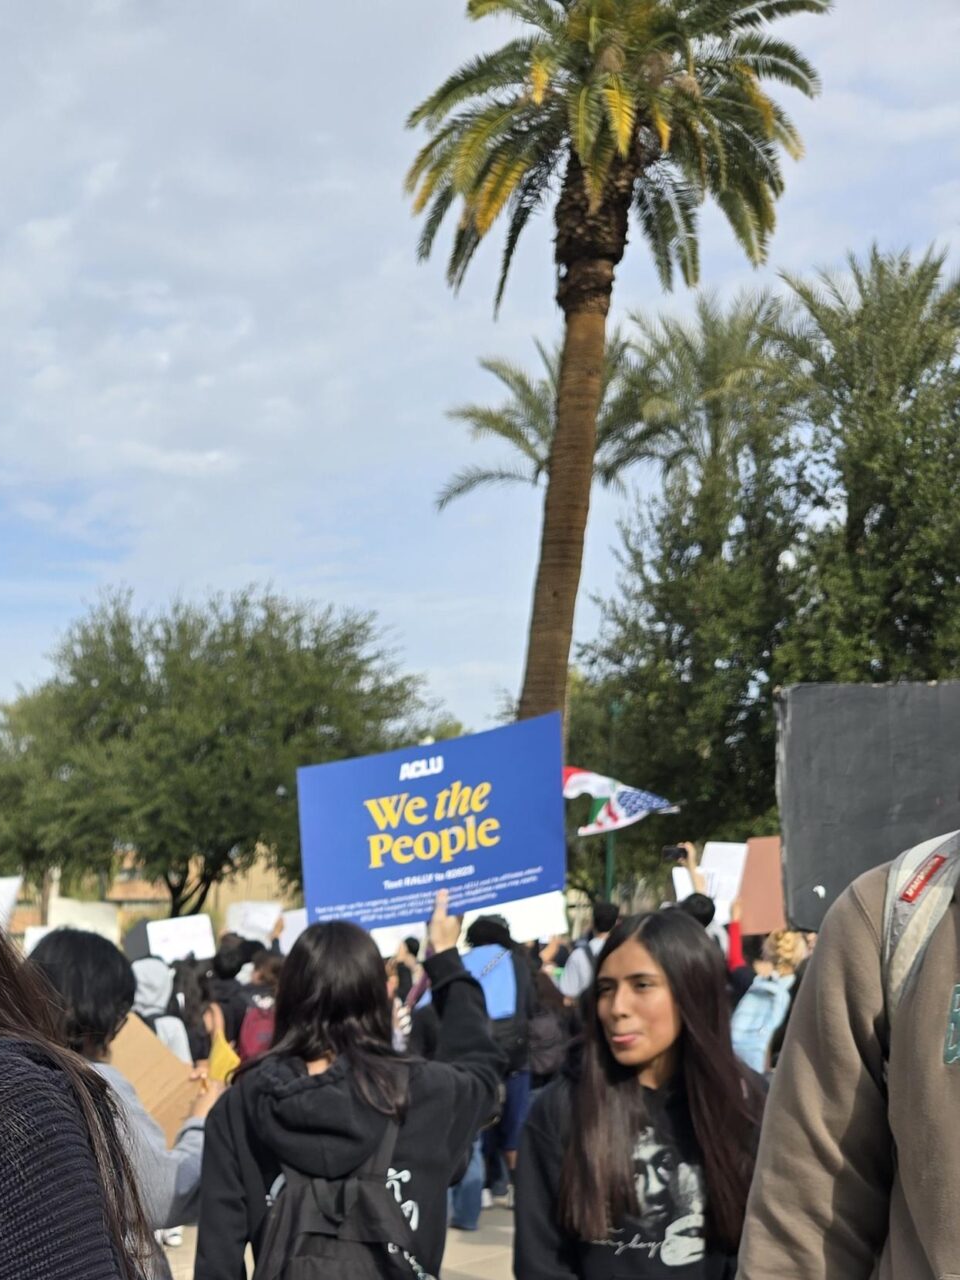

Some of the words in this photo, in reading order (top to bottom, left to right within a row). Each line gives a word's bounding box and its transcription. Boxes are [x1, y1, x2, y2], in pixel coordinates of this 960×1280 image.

[399, 755, 444, 781] ACLU
[363, 792, 428, 831] We
[434, 780, 492, 821] the
[367, 815, 501, 869] People
